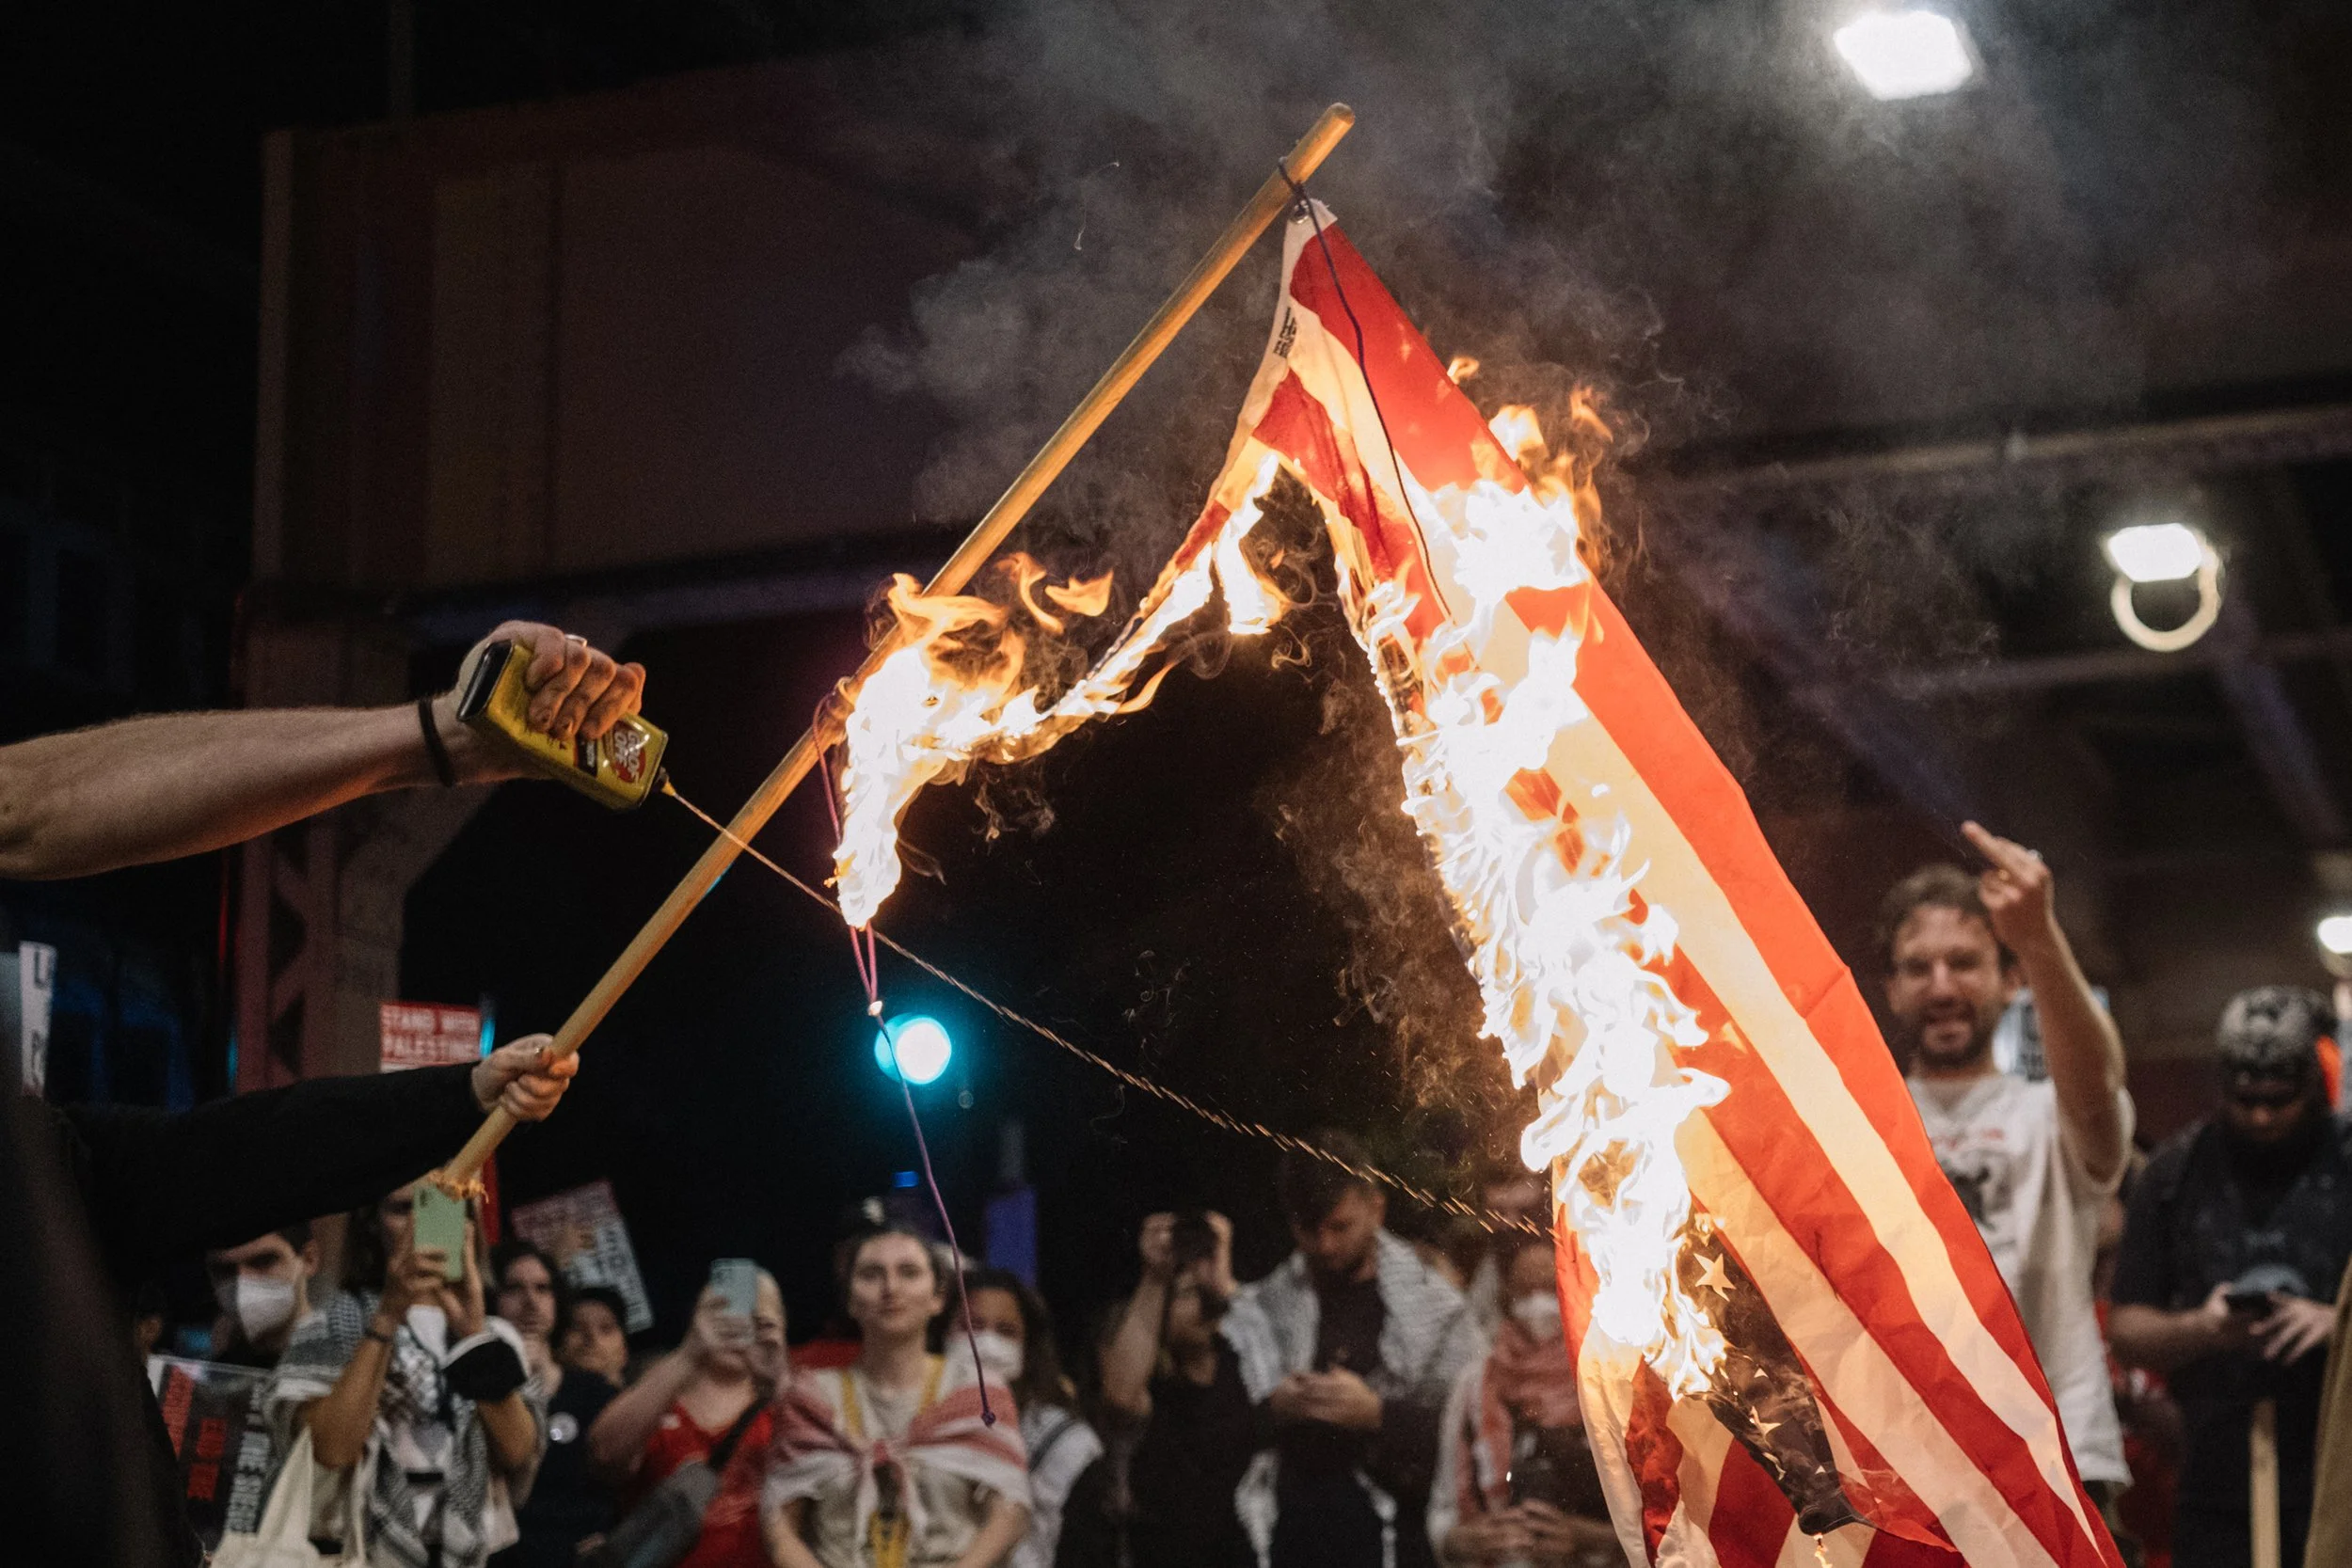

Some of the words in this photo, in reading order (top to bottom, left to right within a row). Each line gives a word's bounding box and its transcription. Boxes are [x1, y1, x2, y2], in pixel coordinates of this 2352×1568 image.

[614, 732, 628, 768] OFF
[628, 730, 642, 786] GOOF
[381, 1034, 479, 1061] PALESTINE
